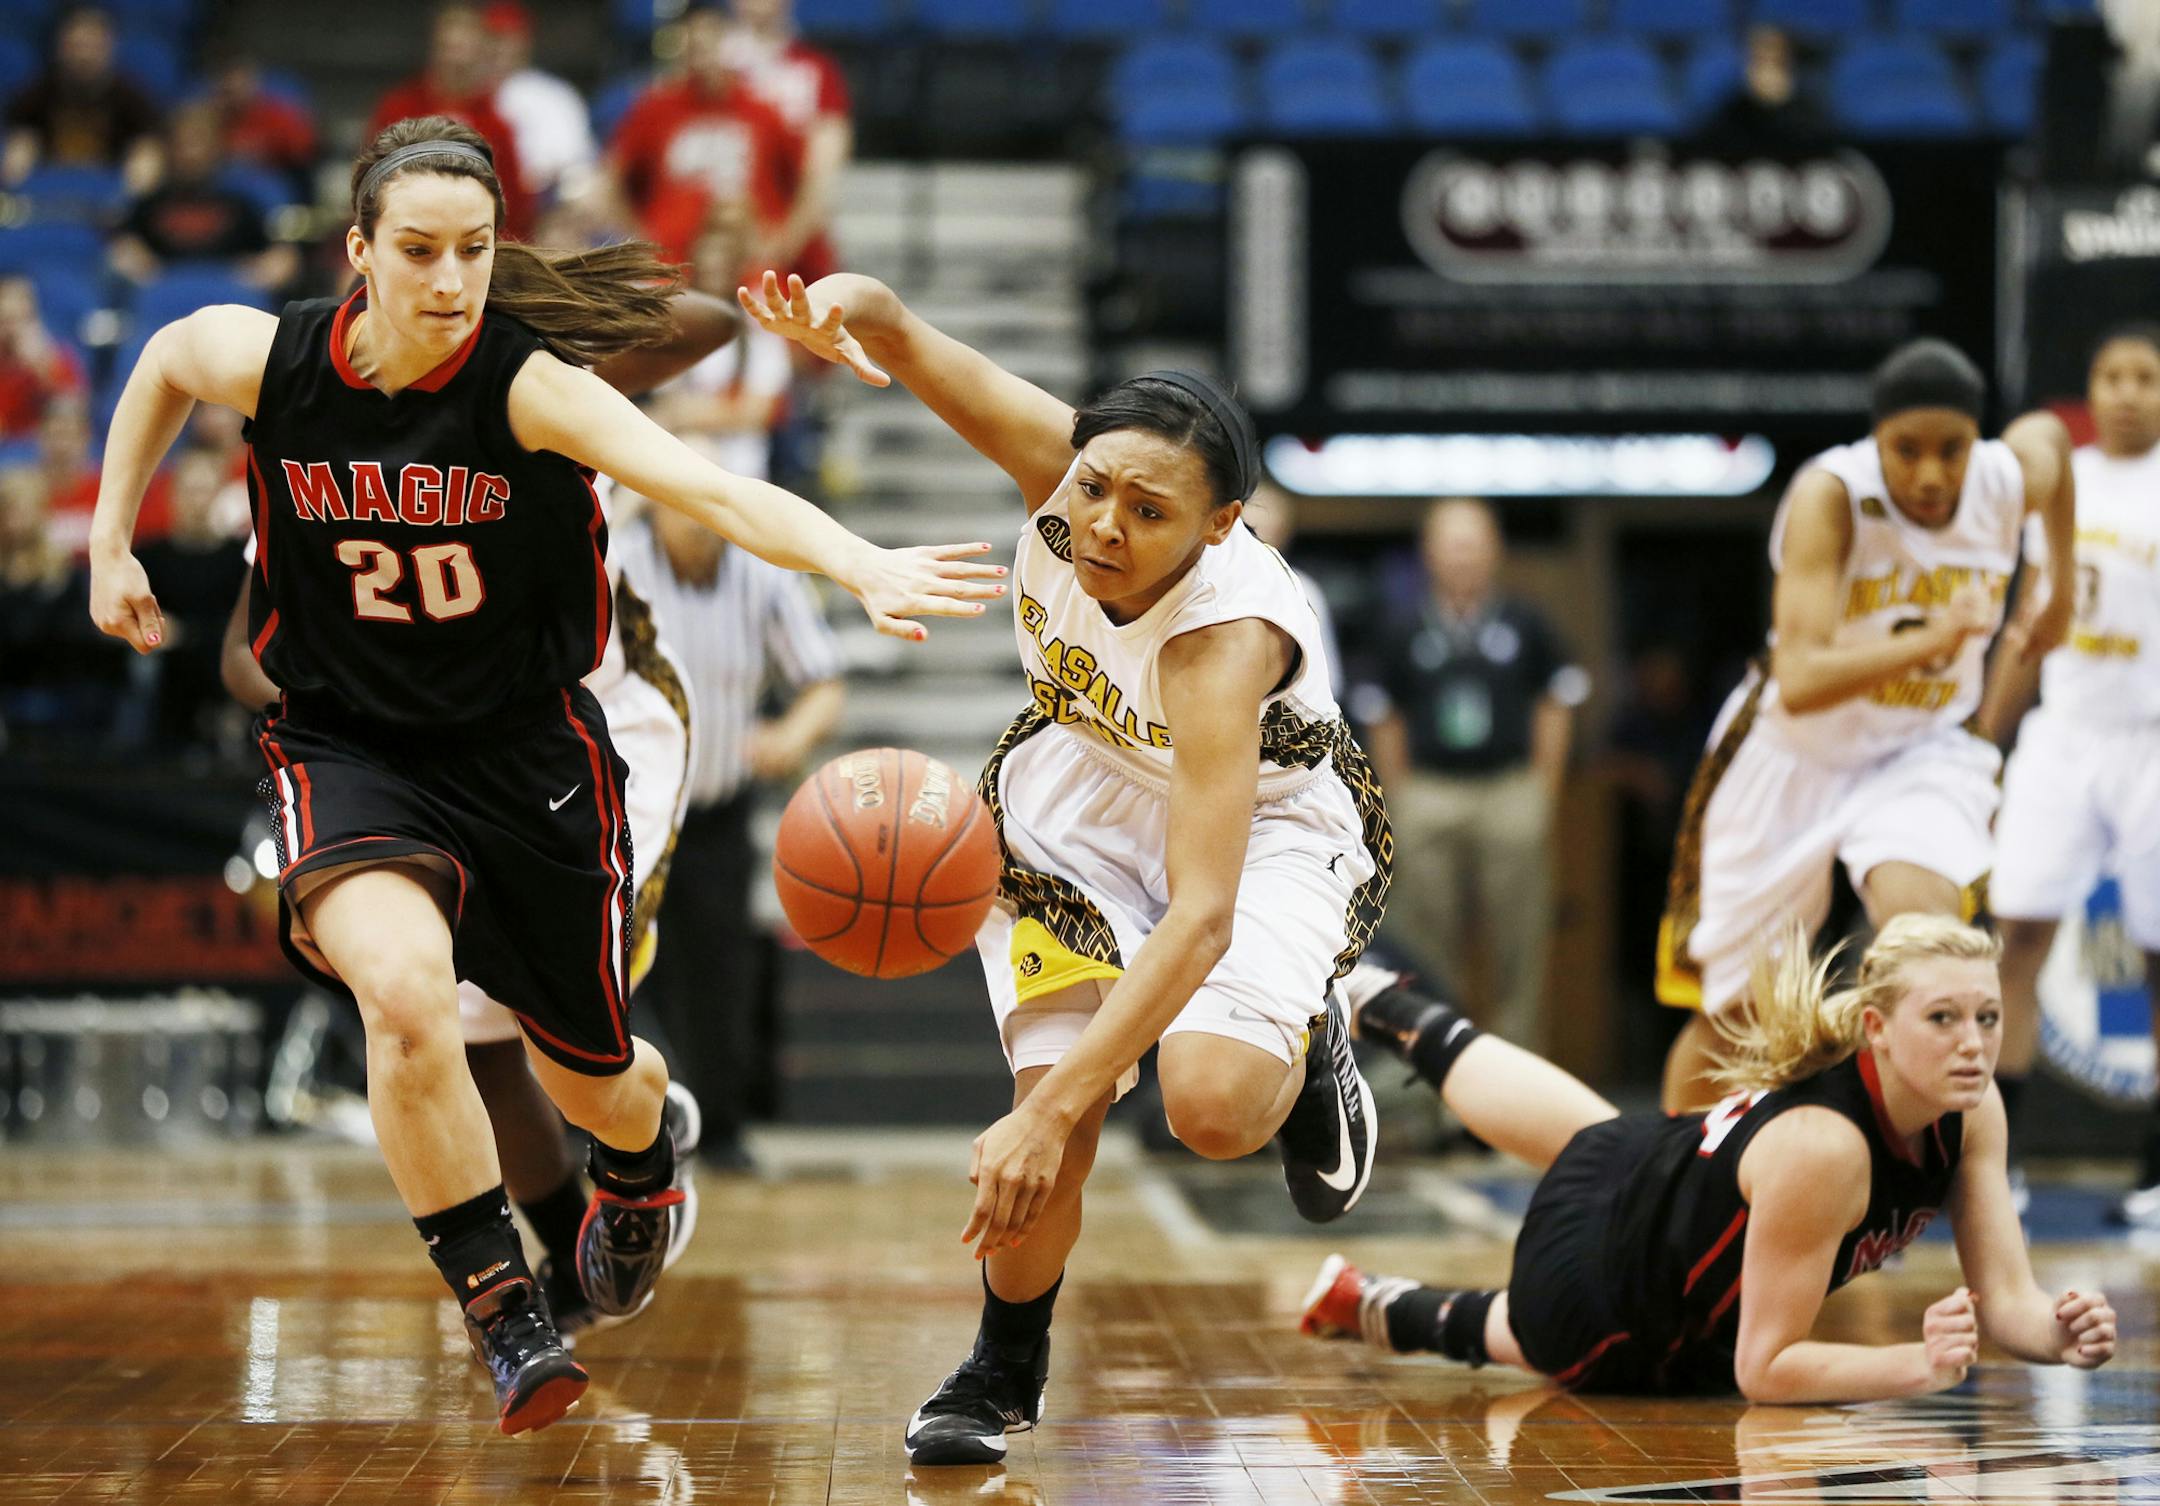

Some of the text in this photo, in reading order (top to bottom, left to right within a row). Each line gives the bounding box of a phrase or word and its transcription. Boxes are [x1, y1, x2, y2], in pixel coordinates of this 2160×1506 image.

[281, 458, 510, 526] MAGIC
[334, 538, 487, 624] 20
[1018, 590, 1174, 750] ELASALLE
